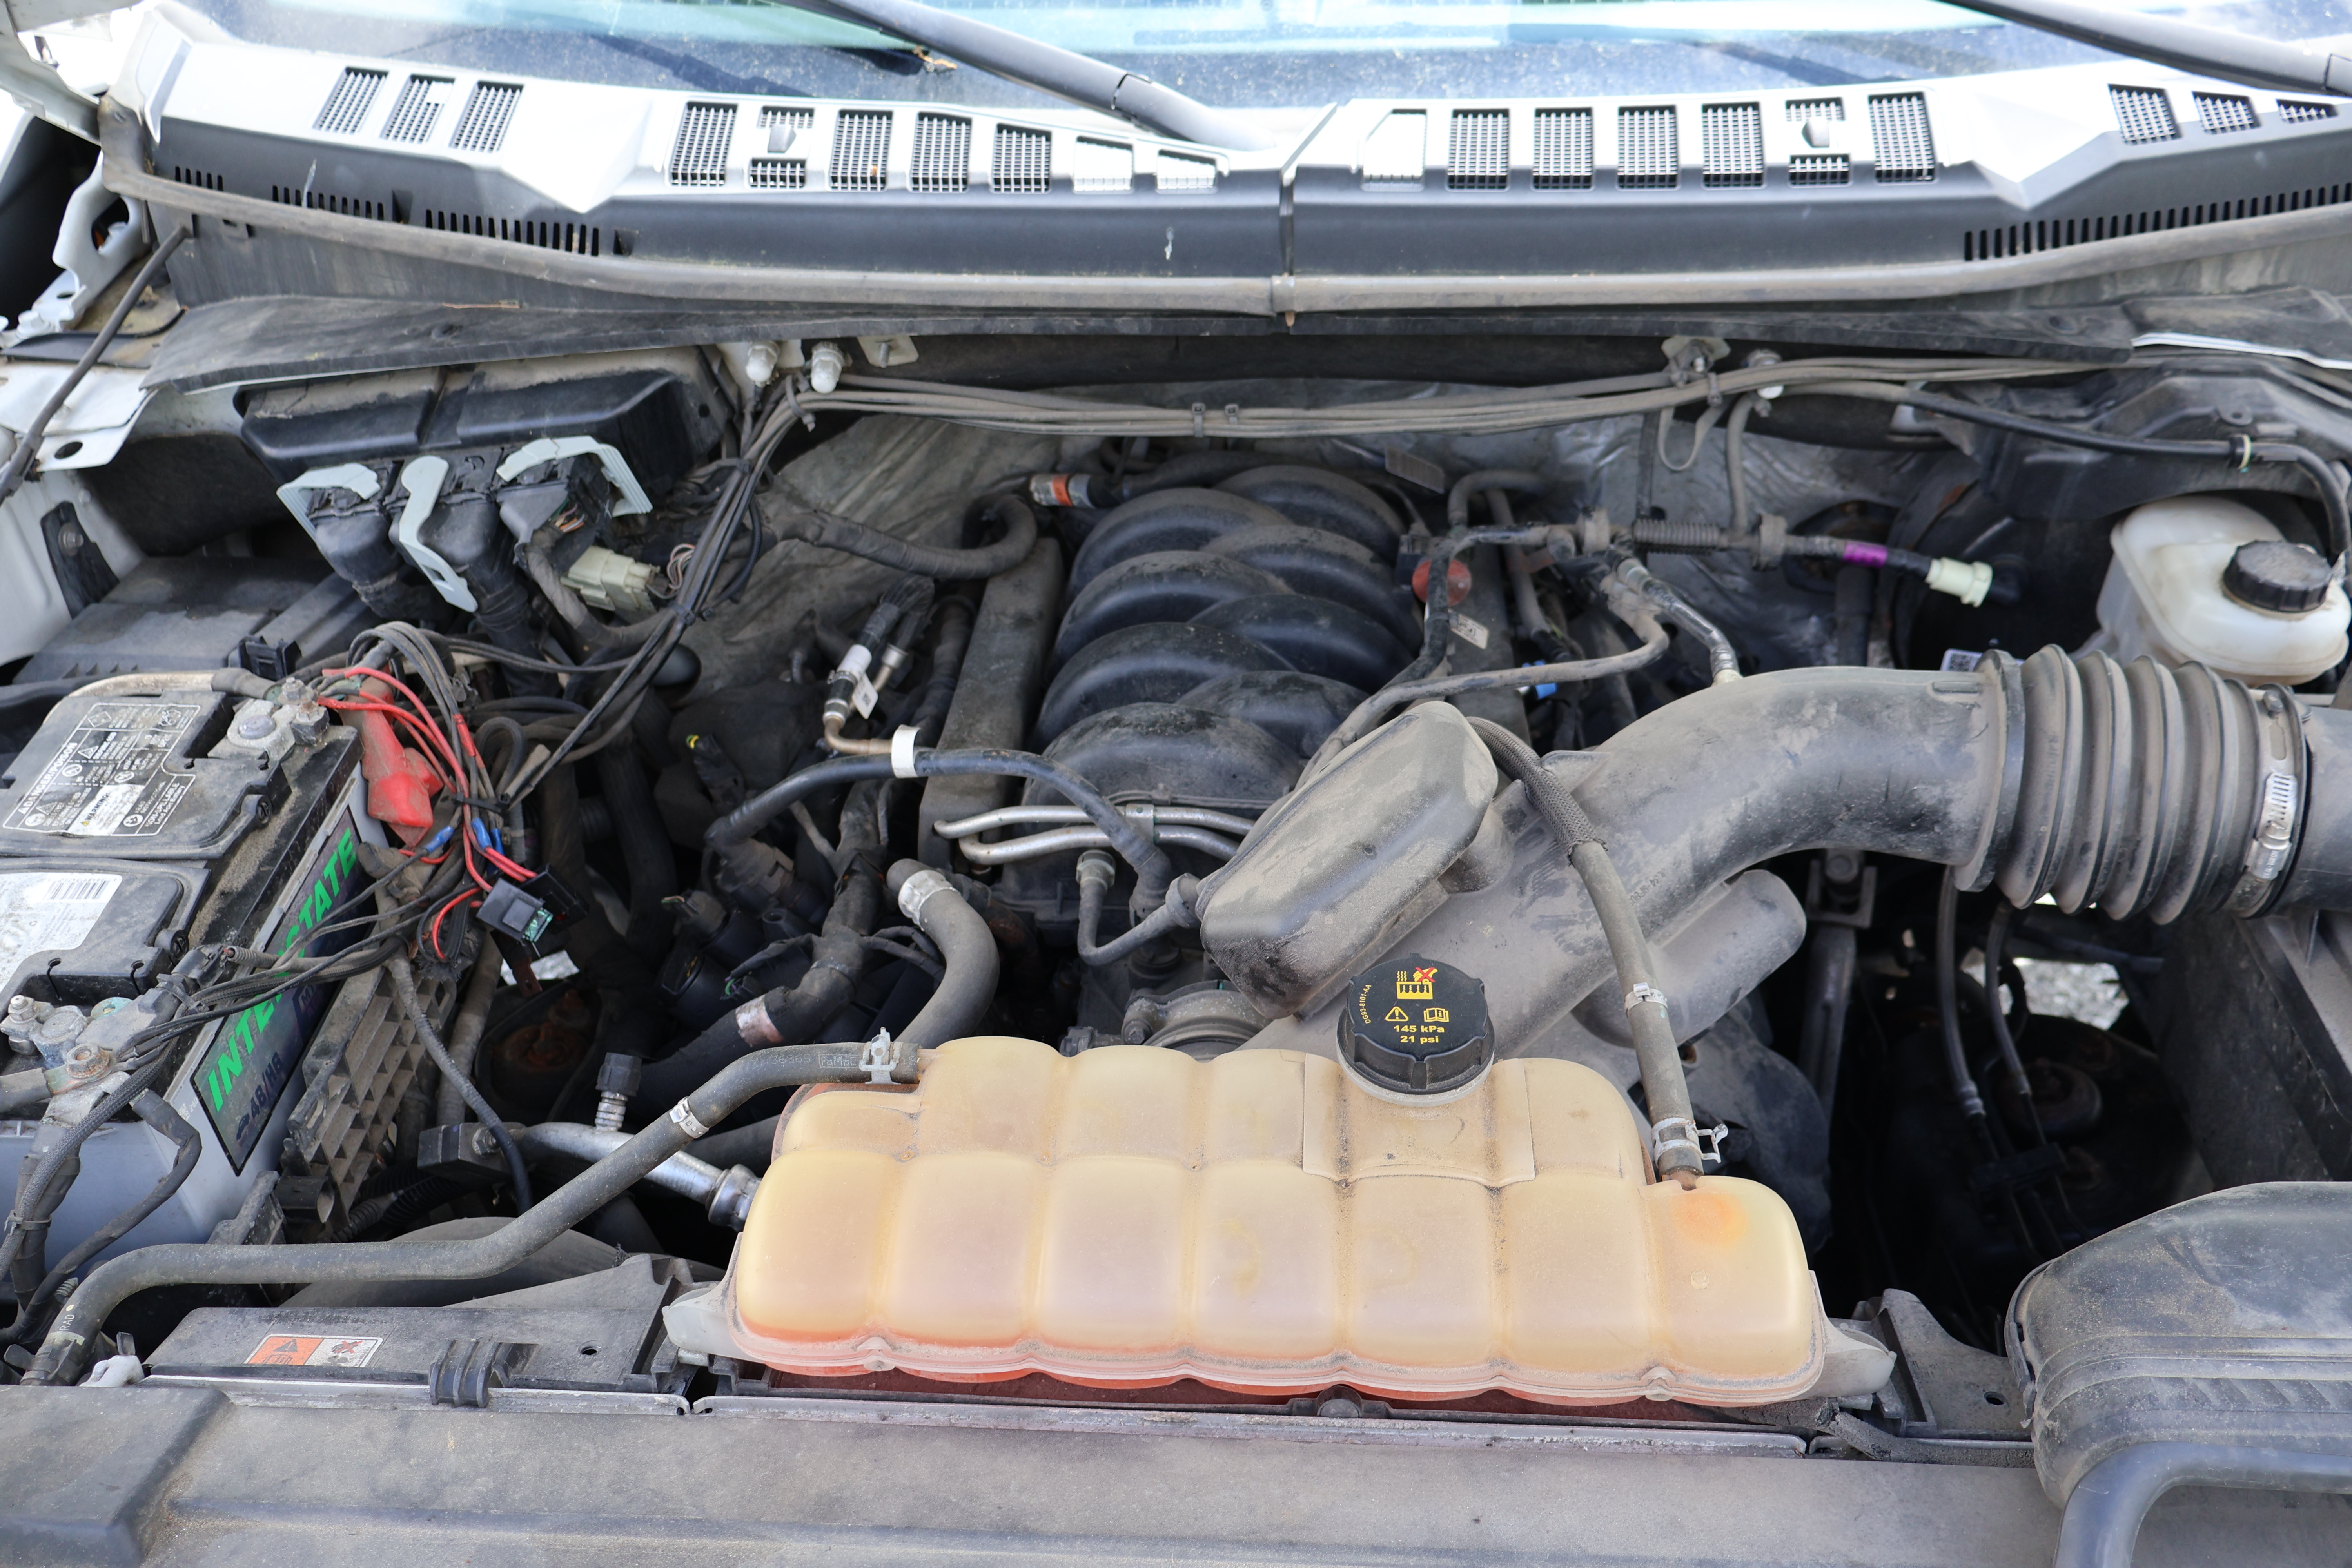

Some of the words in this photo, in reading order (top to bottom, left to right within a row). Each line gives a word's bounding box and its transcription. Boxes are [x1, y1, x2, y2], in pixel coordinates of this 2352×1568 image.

[208, 828, 358, 1112] INTESTATE
[1359, 984, 1372, 1024] DG93-8101-AA
[1420, 1036, 1439, 1044] psi
[821, 1056, 861, 1067] FoMoC
[250, 1052, 283, 1119] 48/H6
[59, 1314, 75, 1332] RAD
